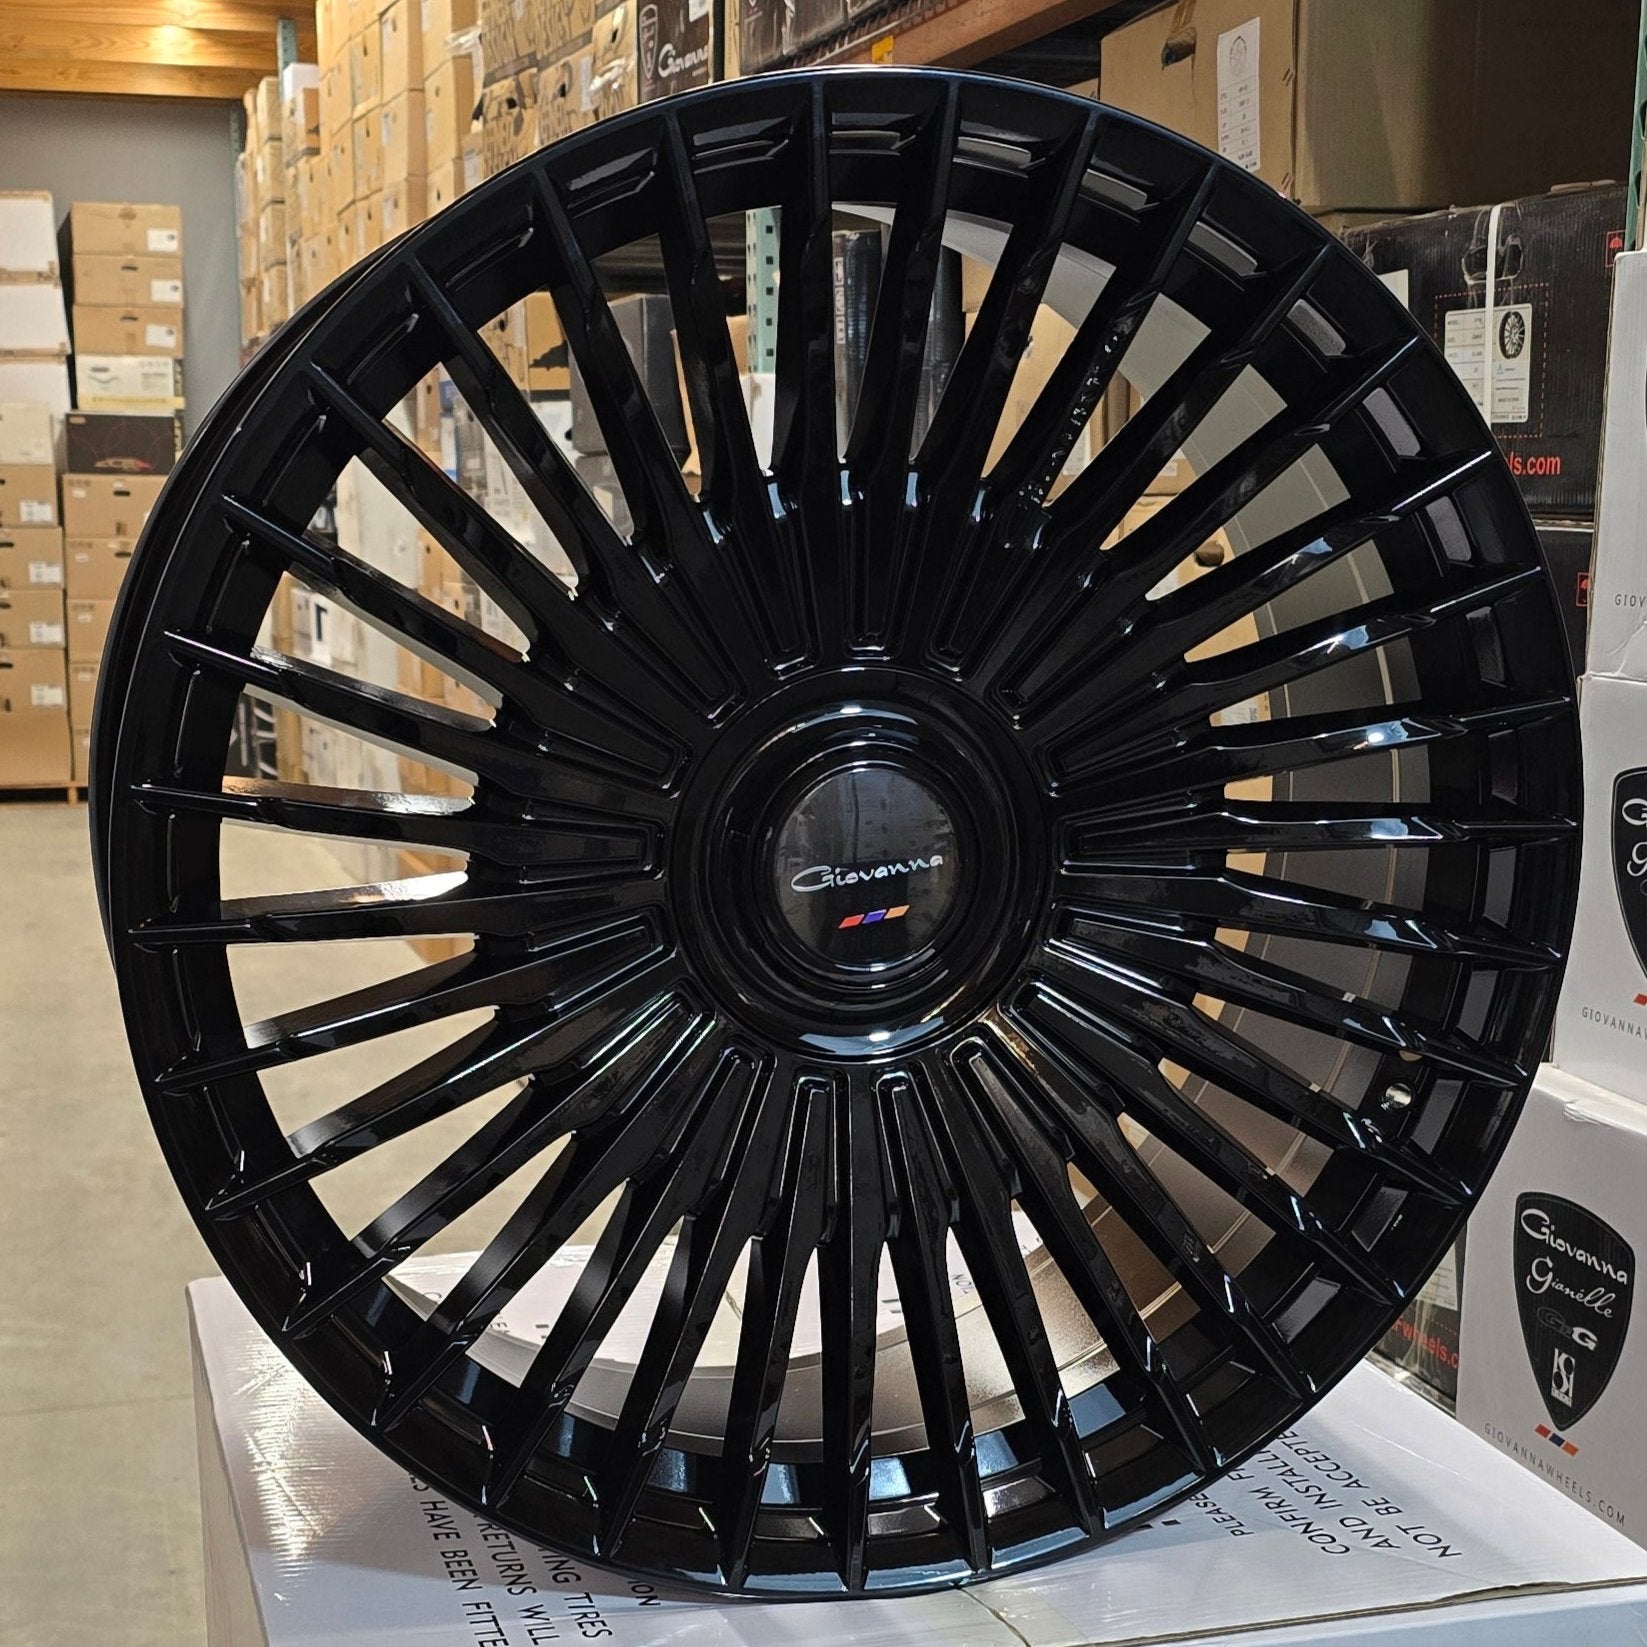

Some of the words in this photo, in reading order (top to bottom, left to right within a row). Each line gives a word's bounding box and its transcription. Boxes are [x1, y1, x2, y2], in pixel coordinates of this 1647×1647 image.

[1508, 451, 1561, 475] ls.com
[790, 854, 945, 893] Giovanna
[1520, 1207, 1628, 1286] Giovanna
[1484, 1423, 1626, 1527] GIOVANNAWHEELS.COM
[420, 1500, 461, 1540] HAVE
[1189, 1492, 1255, 1537] PLEASE
[1248, 1486, 1350, 1554] CONFIRM
[1361, 1497, 1404, 1516] BE
[1339, 1516, 1402, 1549] AND
[1396, 1525, 1463, 1558] NOT
[440, 1550, 483, 1591] BEEN
[477, 1523, 537, 1596] RETURNS
[517, 1604, 560, 1646] WILL
[564, 1592, 613, 1639] TIRES
